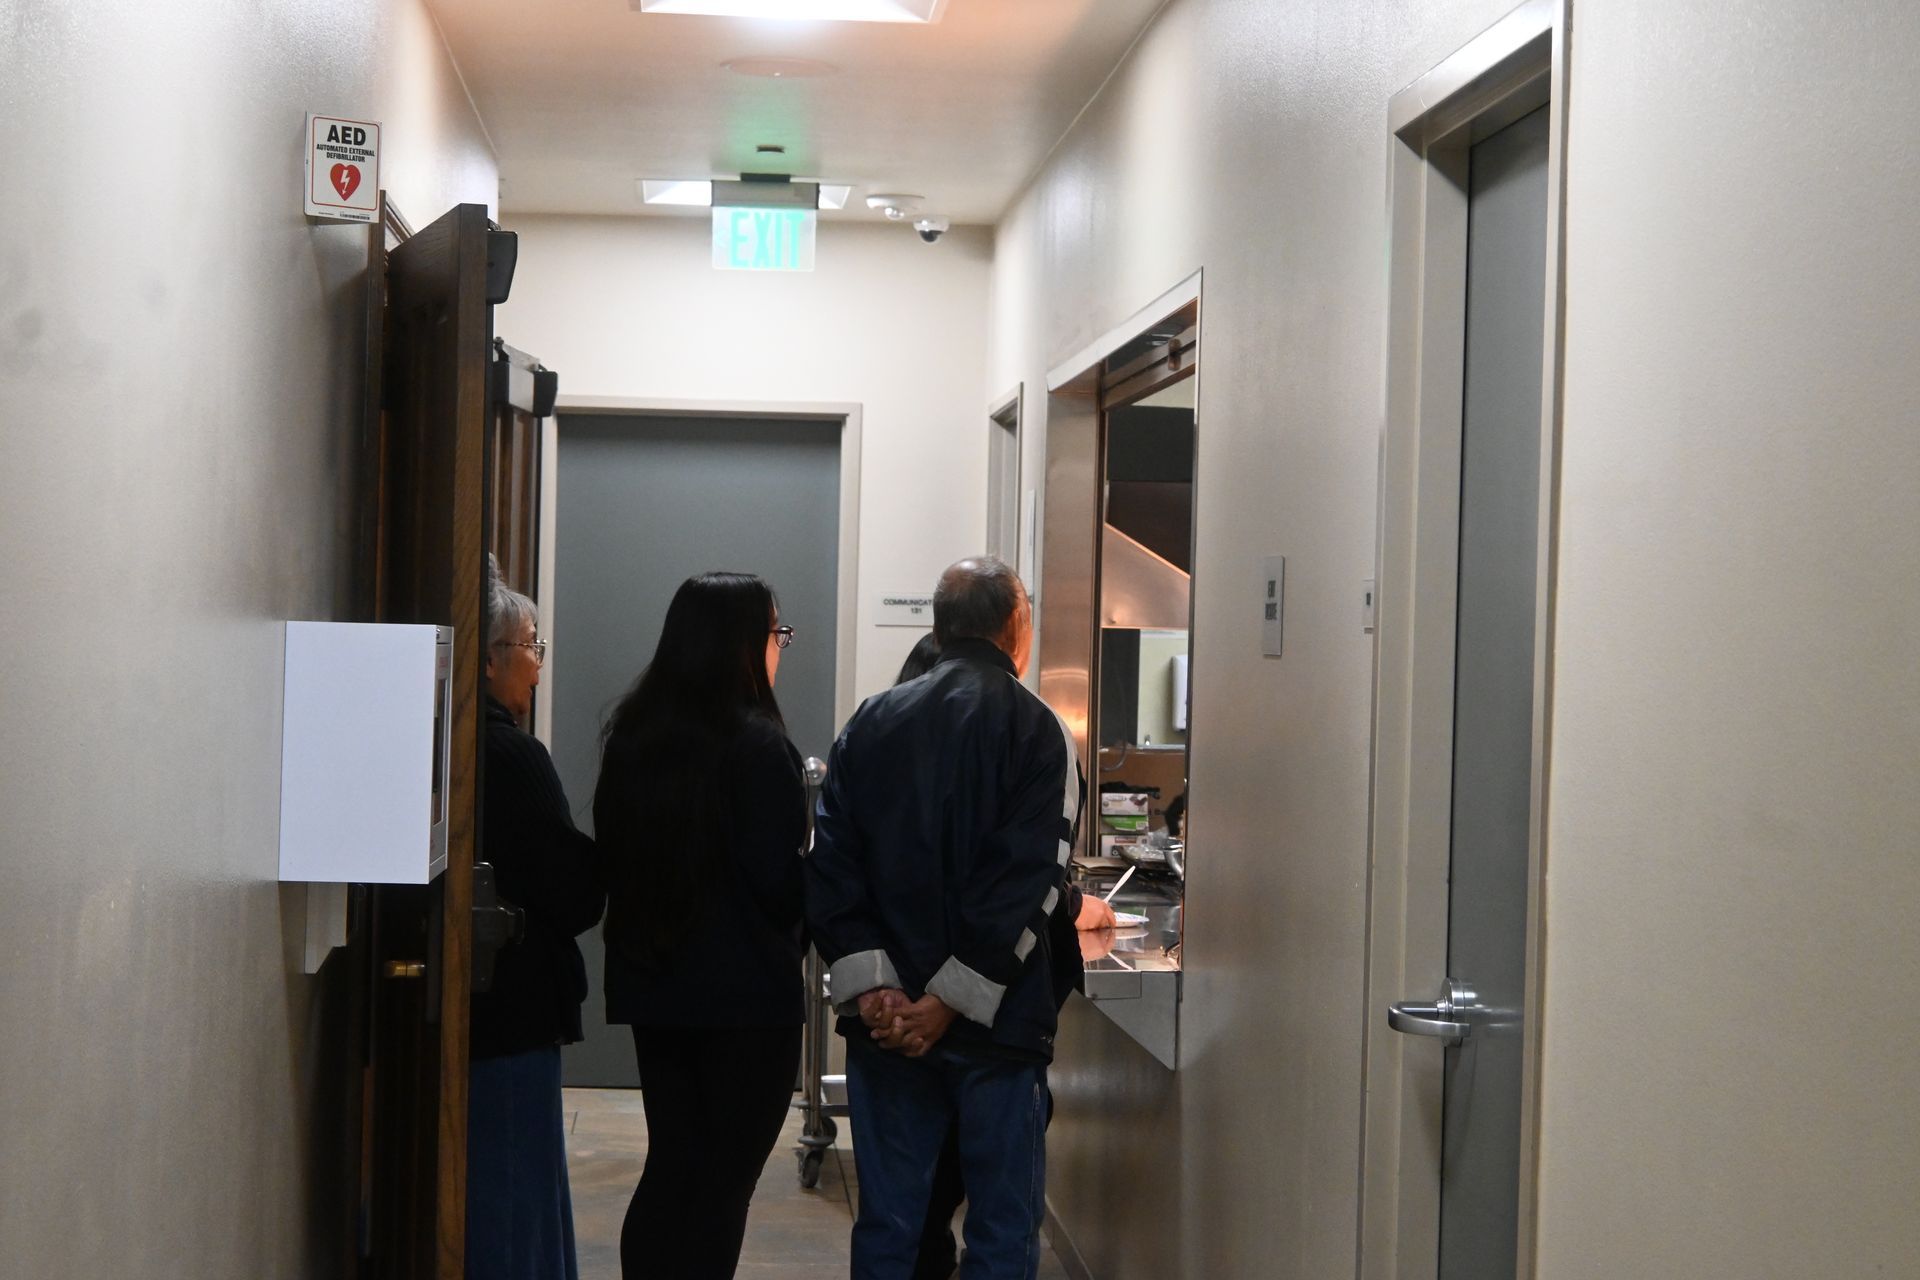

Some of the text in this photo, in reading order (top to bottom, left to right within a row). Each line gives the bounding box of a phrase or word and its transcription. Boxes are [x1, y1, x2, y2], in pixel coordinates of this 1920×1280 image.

[327, 124, 366, 146] AED
[316, 143, 375, 157] AUTOMATED EXTERNAL
[326, 151, 366, 163] DEFIBRILLATOR
[730, 210, 805, 268] EXIT
[883, 598, 932, 606] COMMUNICAT
